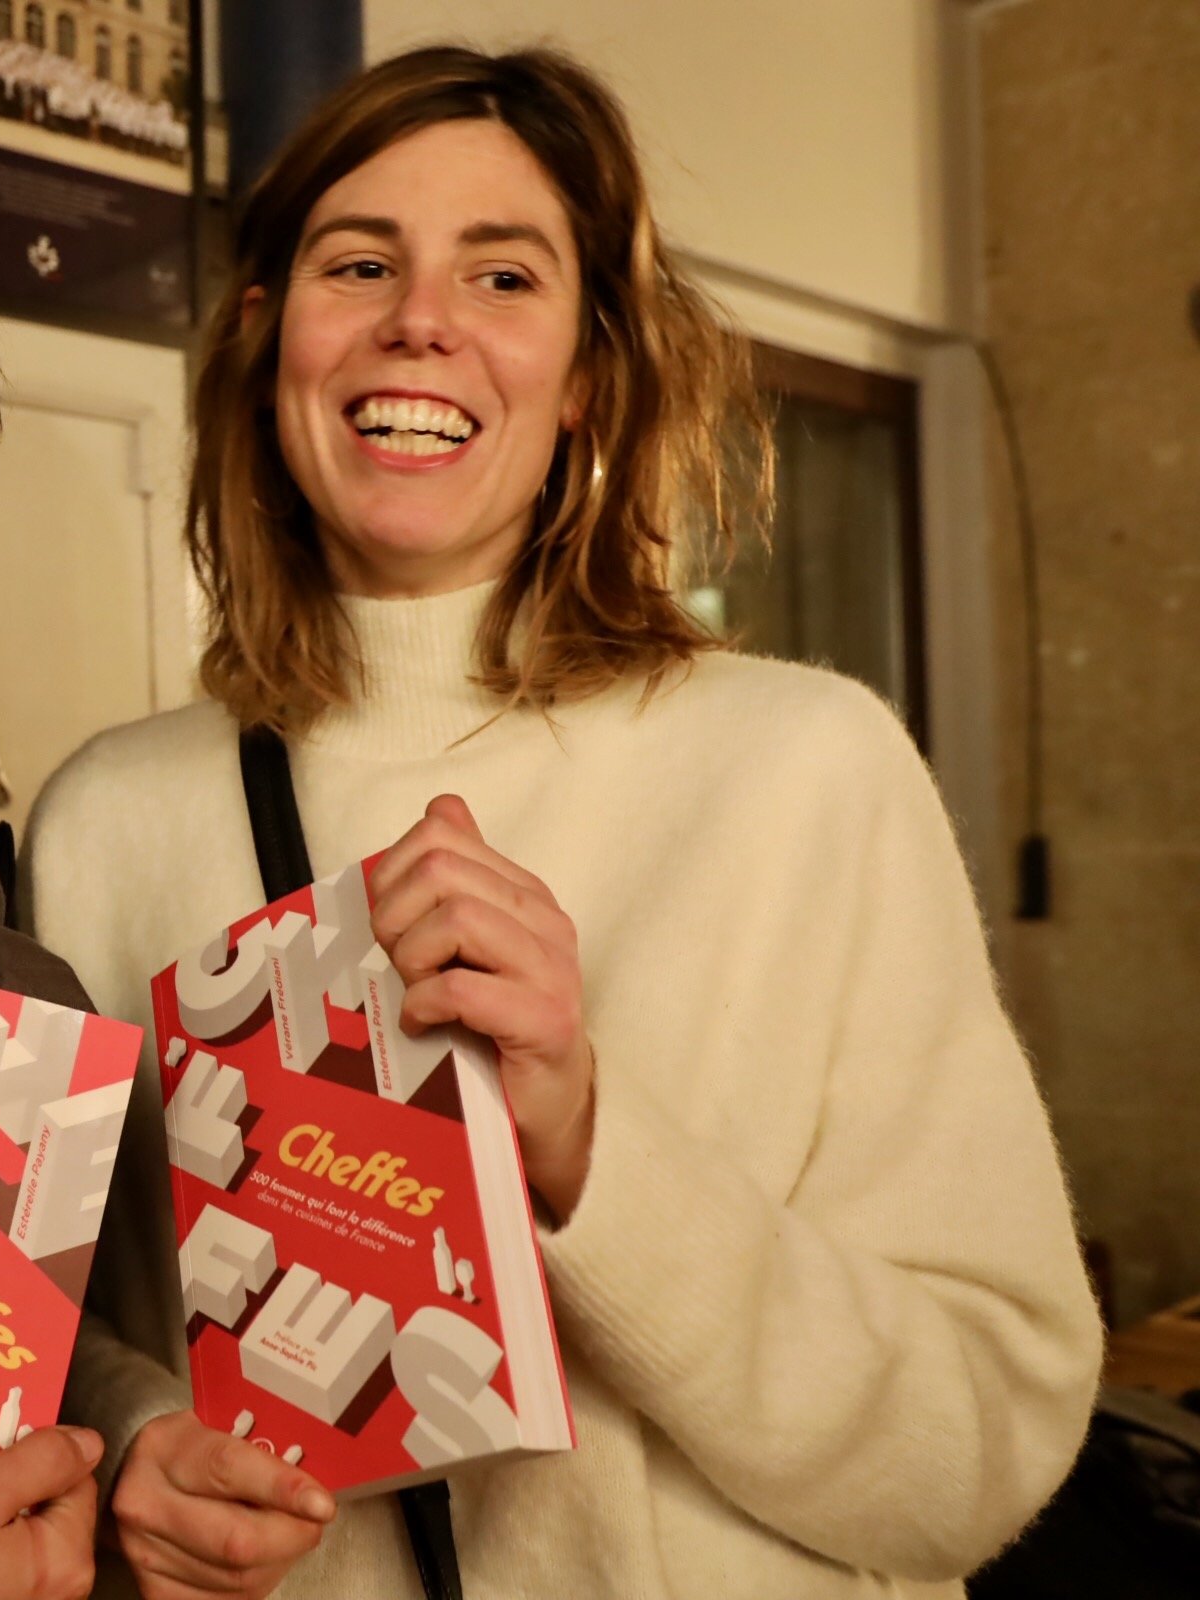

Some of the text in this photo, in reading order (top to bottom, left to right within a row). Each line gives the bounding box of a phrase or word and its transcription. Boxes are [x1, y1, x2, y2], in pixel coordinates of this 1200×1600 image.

[272, 957, 294, 1060] Vérane Frédiani
[368, 978, 392, 1090] Estérelle Payany
[16, 1124, 51, 1240] Estérelle Payany
[249, 1170, 416, 1248] 500 femmes qui font la différence
[278, 1124, 445, 1217] Cheffes
[257, 1192, 386, 1252] dans les cuisines de France
